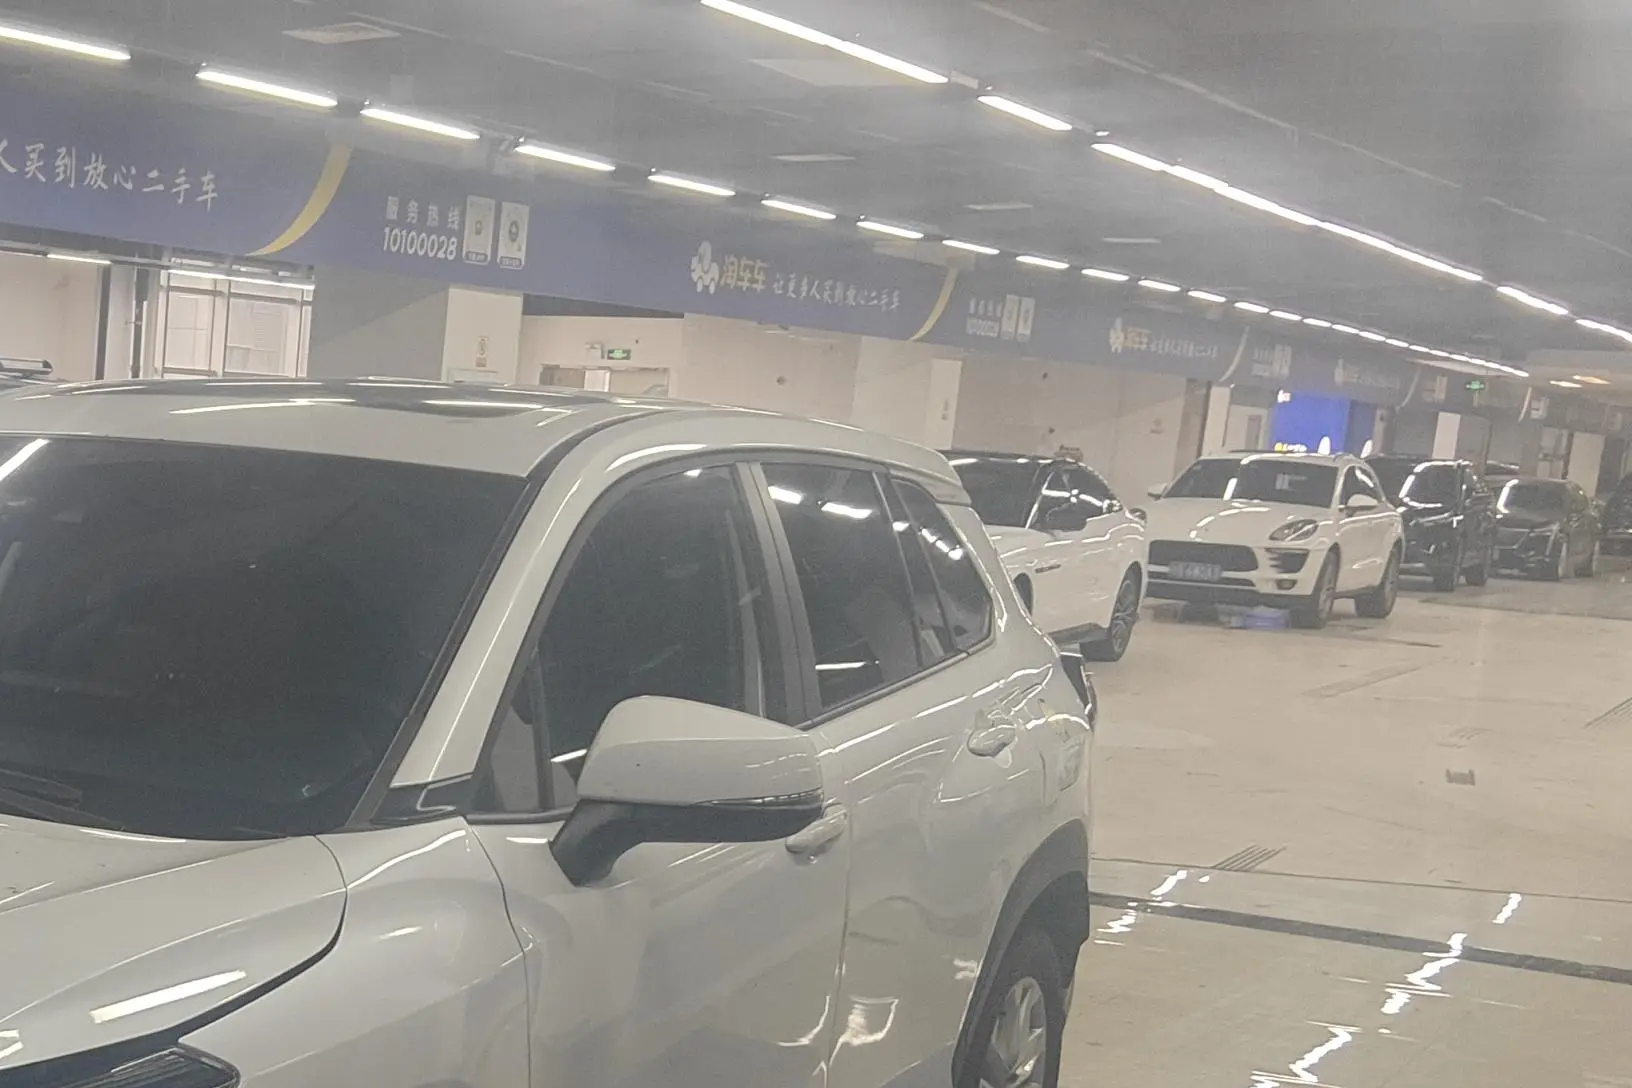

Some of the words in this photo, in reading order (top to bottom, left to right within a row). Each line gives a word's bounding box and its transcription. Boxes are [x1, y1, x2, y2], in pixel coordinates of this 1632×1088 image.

[383, 226, 458, 261] 10100028
[720, 254, 768, 293] 淘车车
